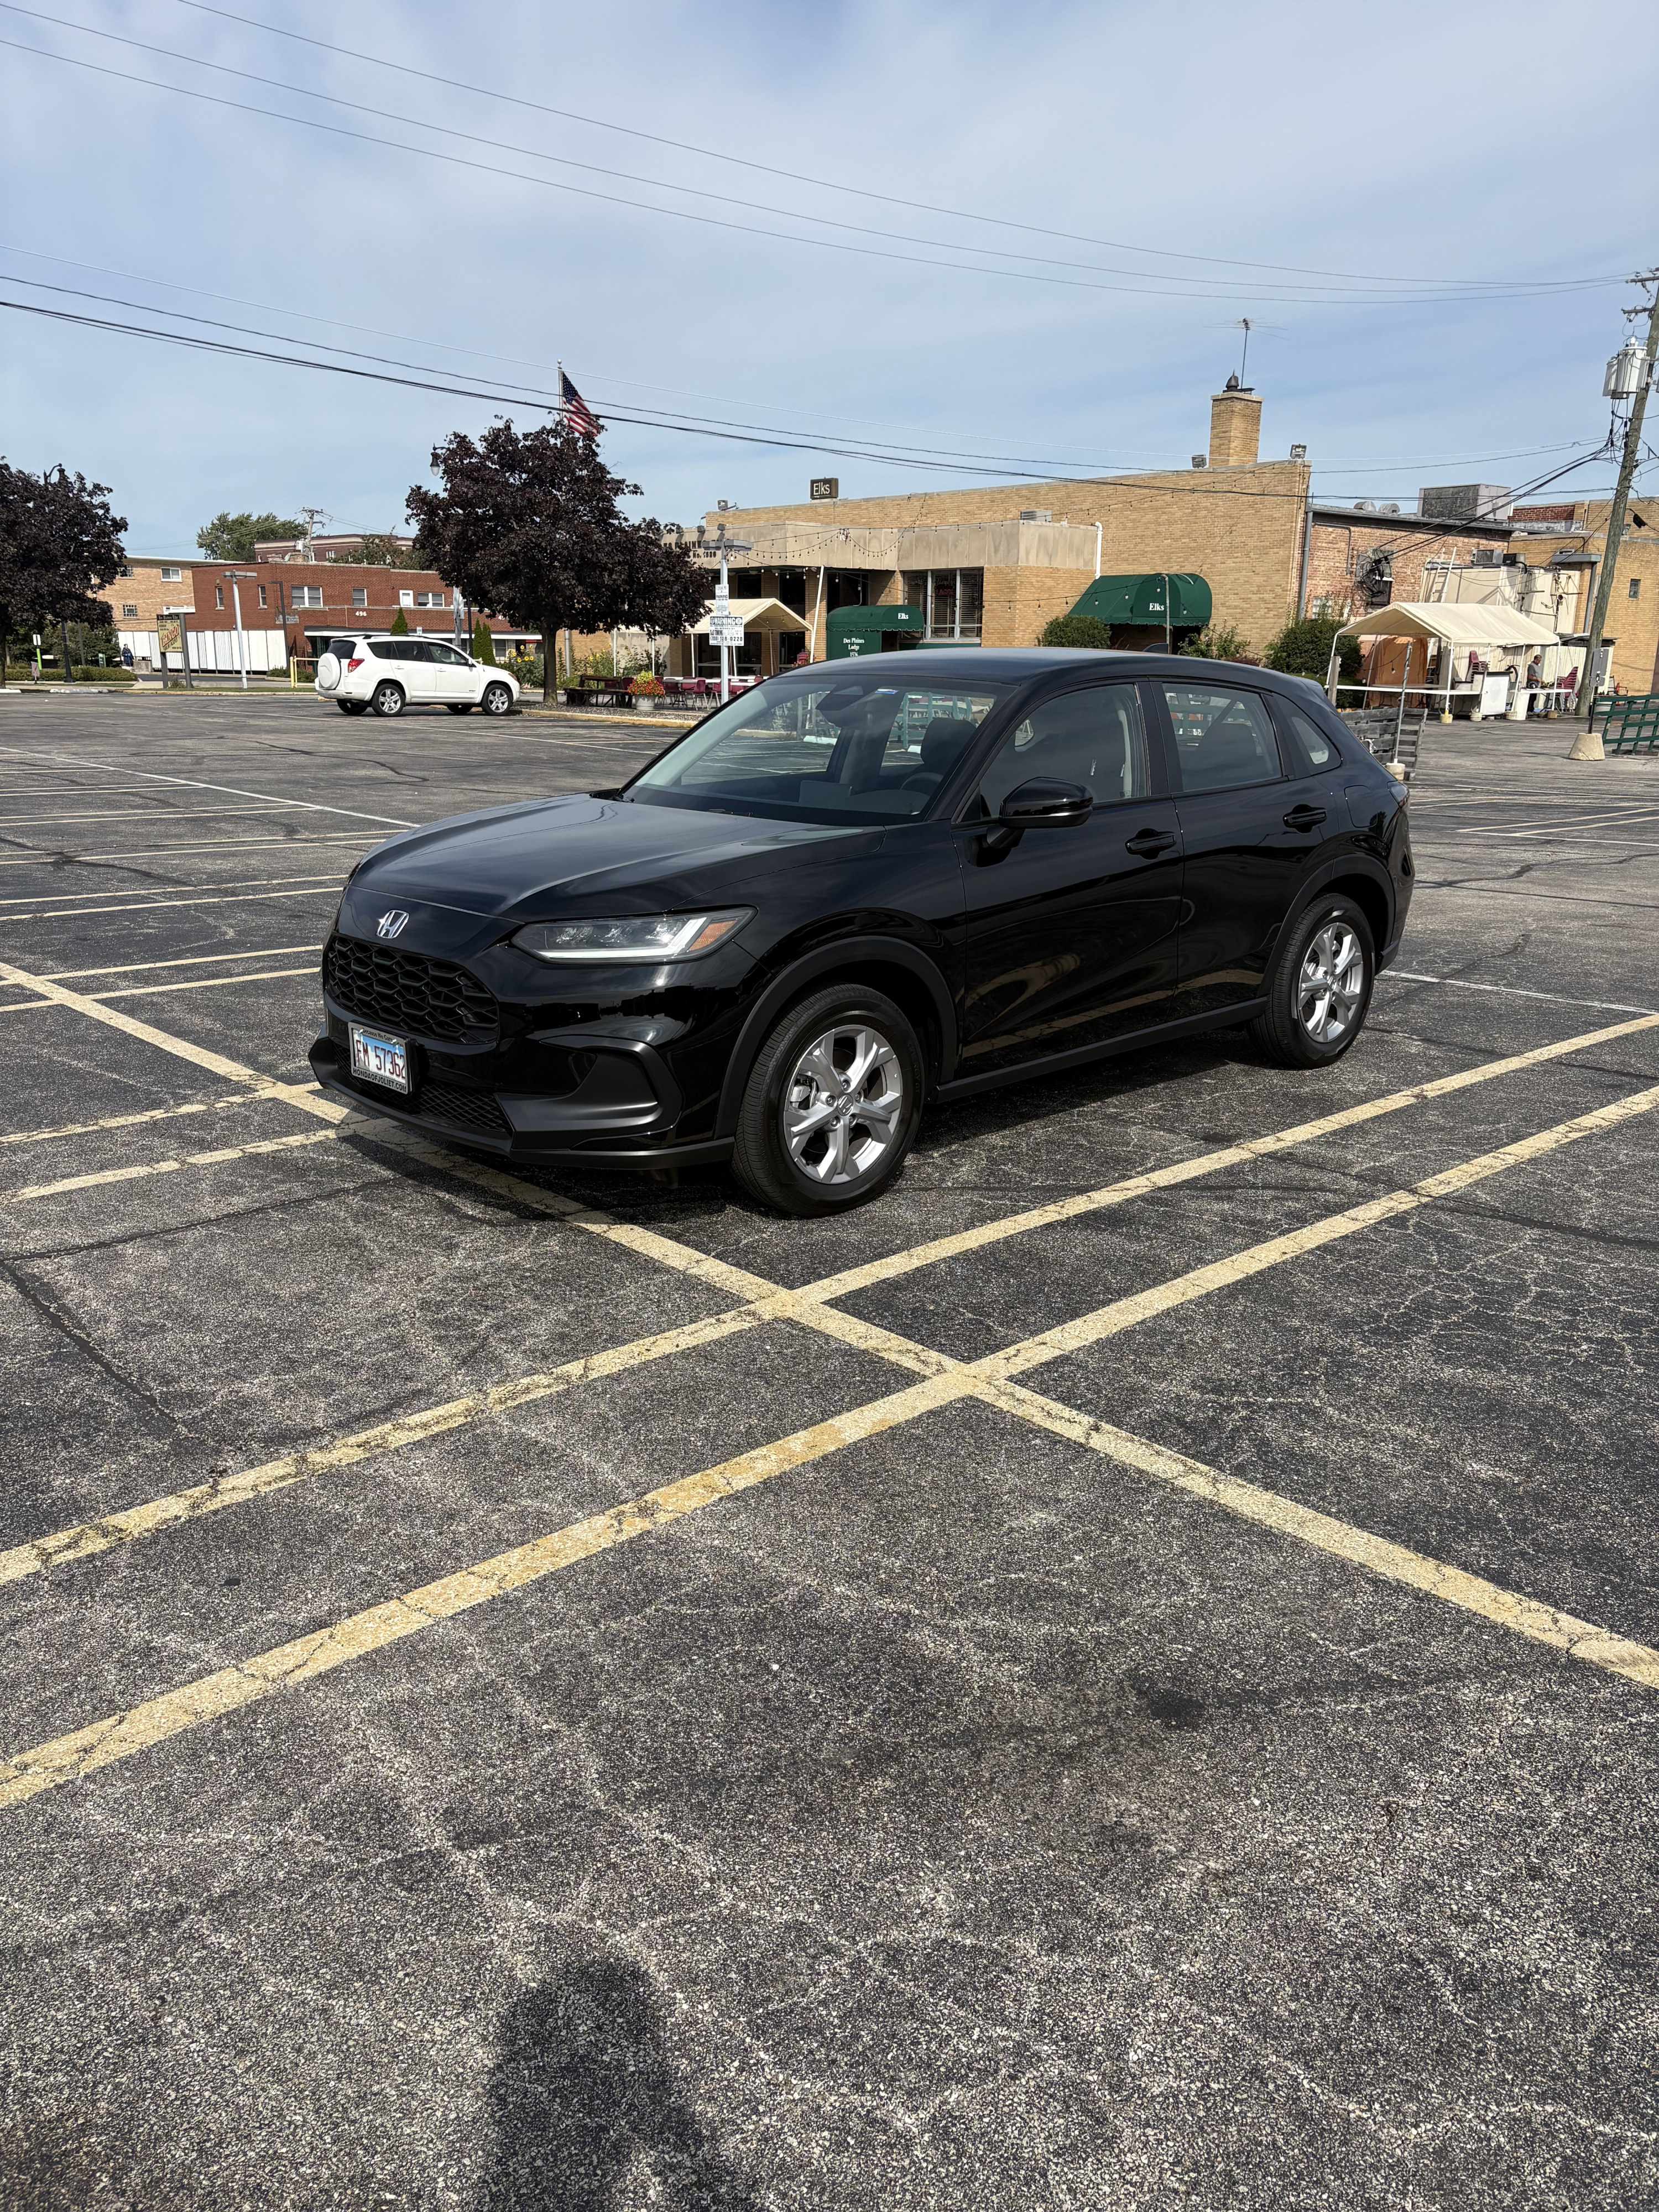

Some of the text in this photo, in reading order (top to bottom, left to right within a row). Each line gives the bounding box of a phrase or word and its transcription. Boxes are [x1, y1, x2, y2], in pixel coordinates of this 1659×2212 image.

[813, 482, 830, 495] Elks
[1149, 603, 1165, 611] Elks
[161, 624, 180, 648] BINGO
[356, 1040, 405, 1079] FM 57362
[353, 1067, 406, 1093] HONDAOFJOLIET.COM
